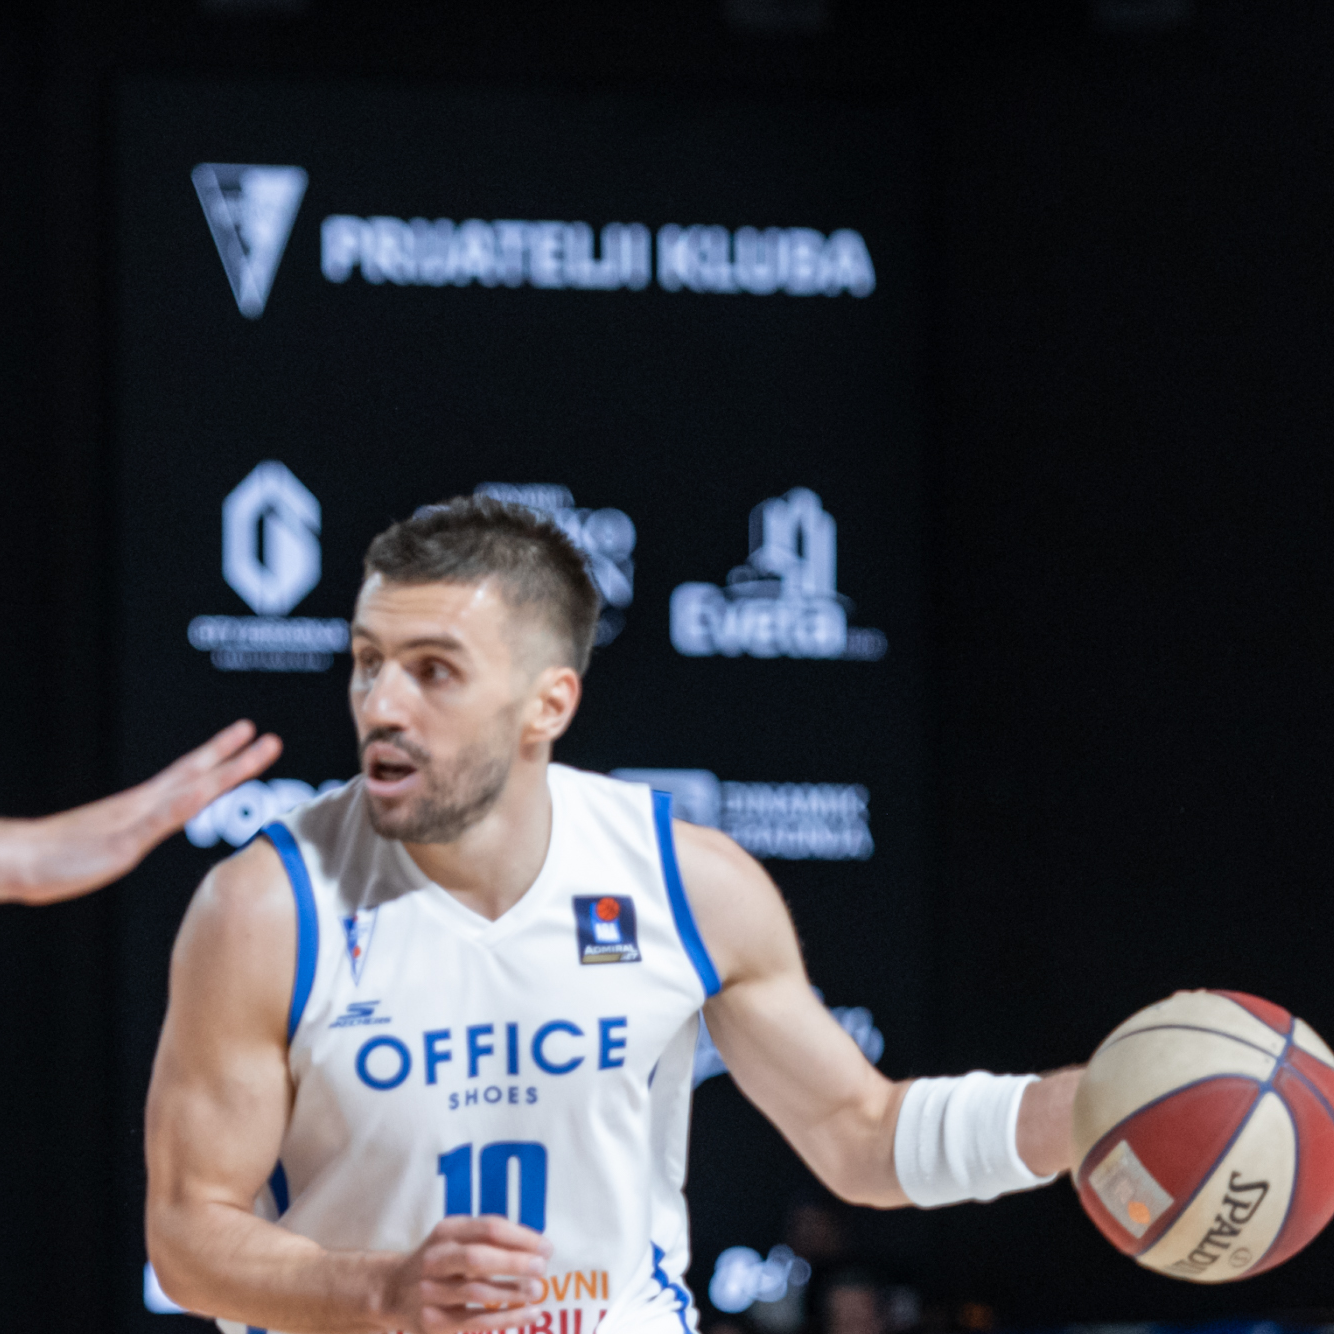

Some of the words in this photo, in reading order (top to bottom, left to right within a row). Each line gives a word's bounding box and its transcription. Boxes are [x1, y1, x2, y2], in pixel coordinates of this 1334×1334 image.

[657, 222, 877, 298] KLUBA
[584, 944, 638, 955] ADMIRAL
[356, 1017, 628, 1092] OFFICE
[448, 1085, 539, 1111] SHOES
[436, 1140, 548, 1235] 10
[1166, 1170, 1271, 1276] SPALD
